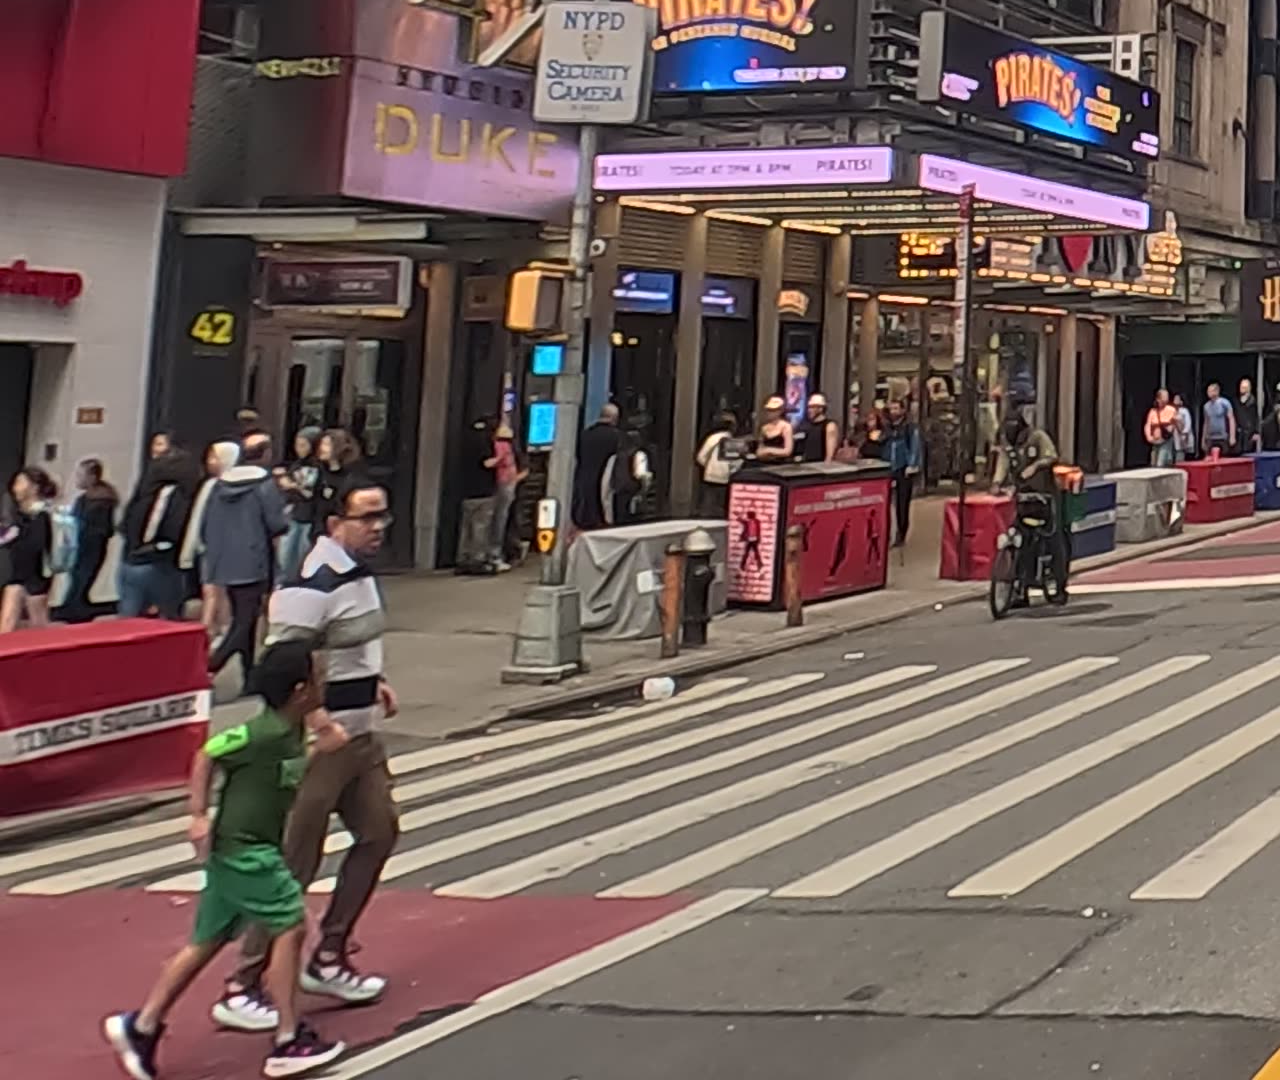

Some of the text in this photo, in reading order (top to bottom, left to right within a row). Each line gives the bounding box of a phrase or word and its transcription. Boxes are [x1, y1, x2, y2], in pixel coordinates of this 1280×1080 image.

[563, 10, 625, 31] NYPD
[548, 81, 624, 102] CAMERA
[993, 53, 1082, 125] PIRATES!
[374, 102, 560, 179] DUKE
[191, 313, 234, 344] 42
